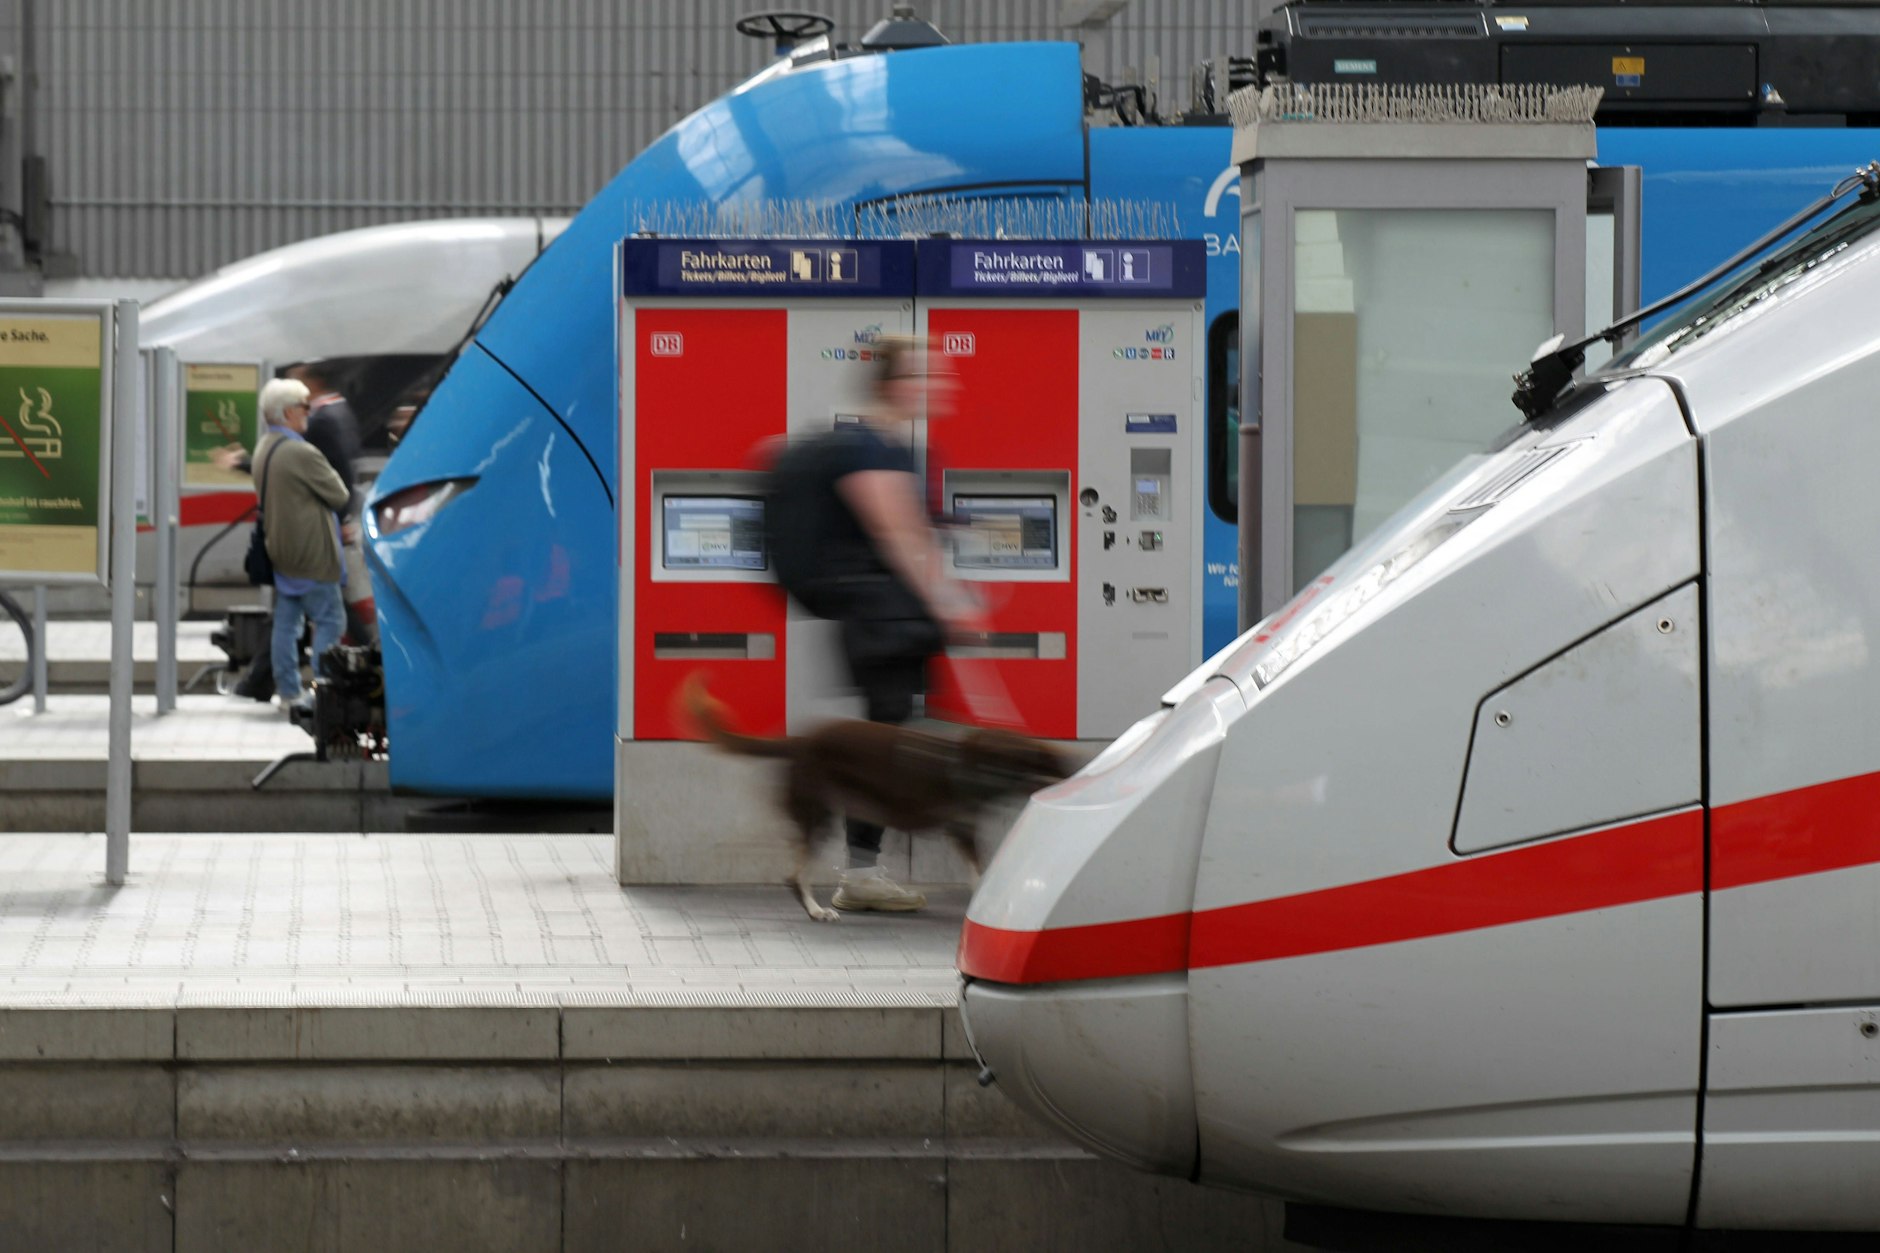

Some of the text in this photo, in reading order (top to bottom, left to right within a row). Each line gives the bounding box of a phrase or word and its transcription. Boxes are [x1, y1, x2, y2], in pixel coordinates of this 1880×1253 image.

[681, 250, 771, 269] Fahrkarten
[974, 251, 1063, 270] Fahrkarten
[654, 334, 680, 354] DB
[947, 334, 973, 354] DB
